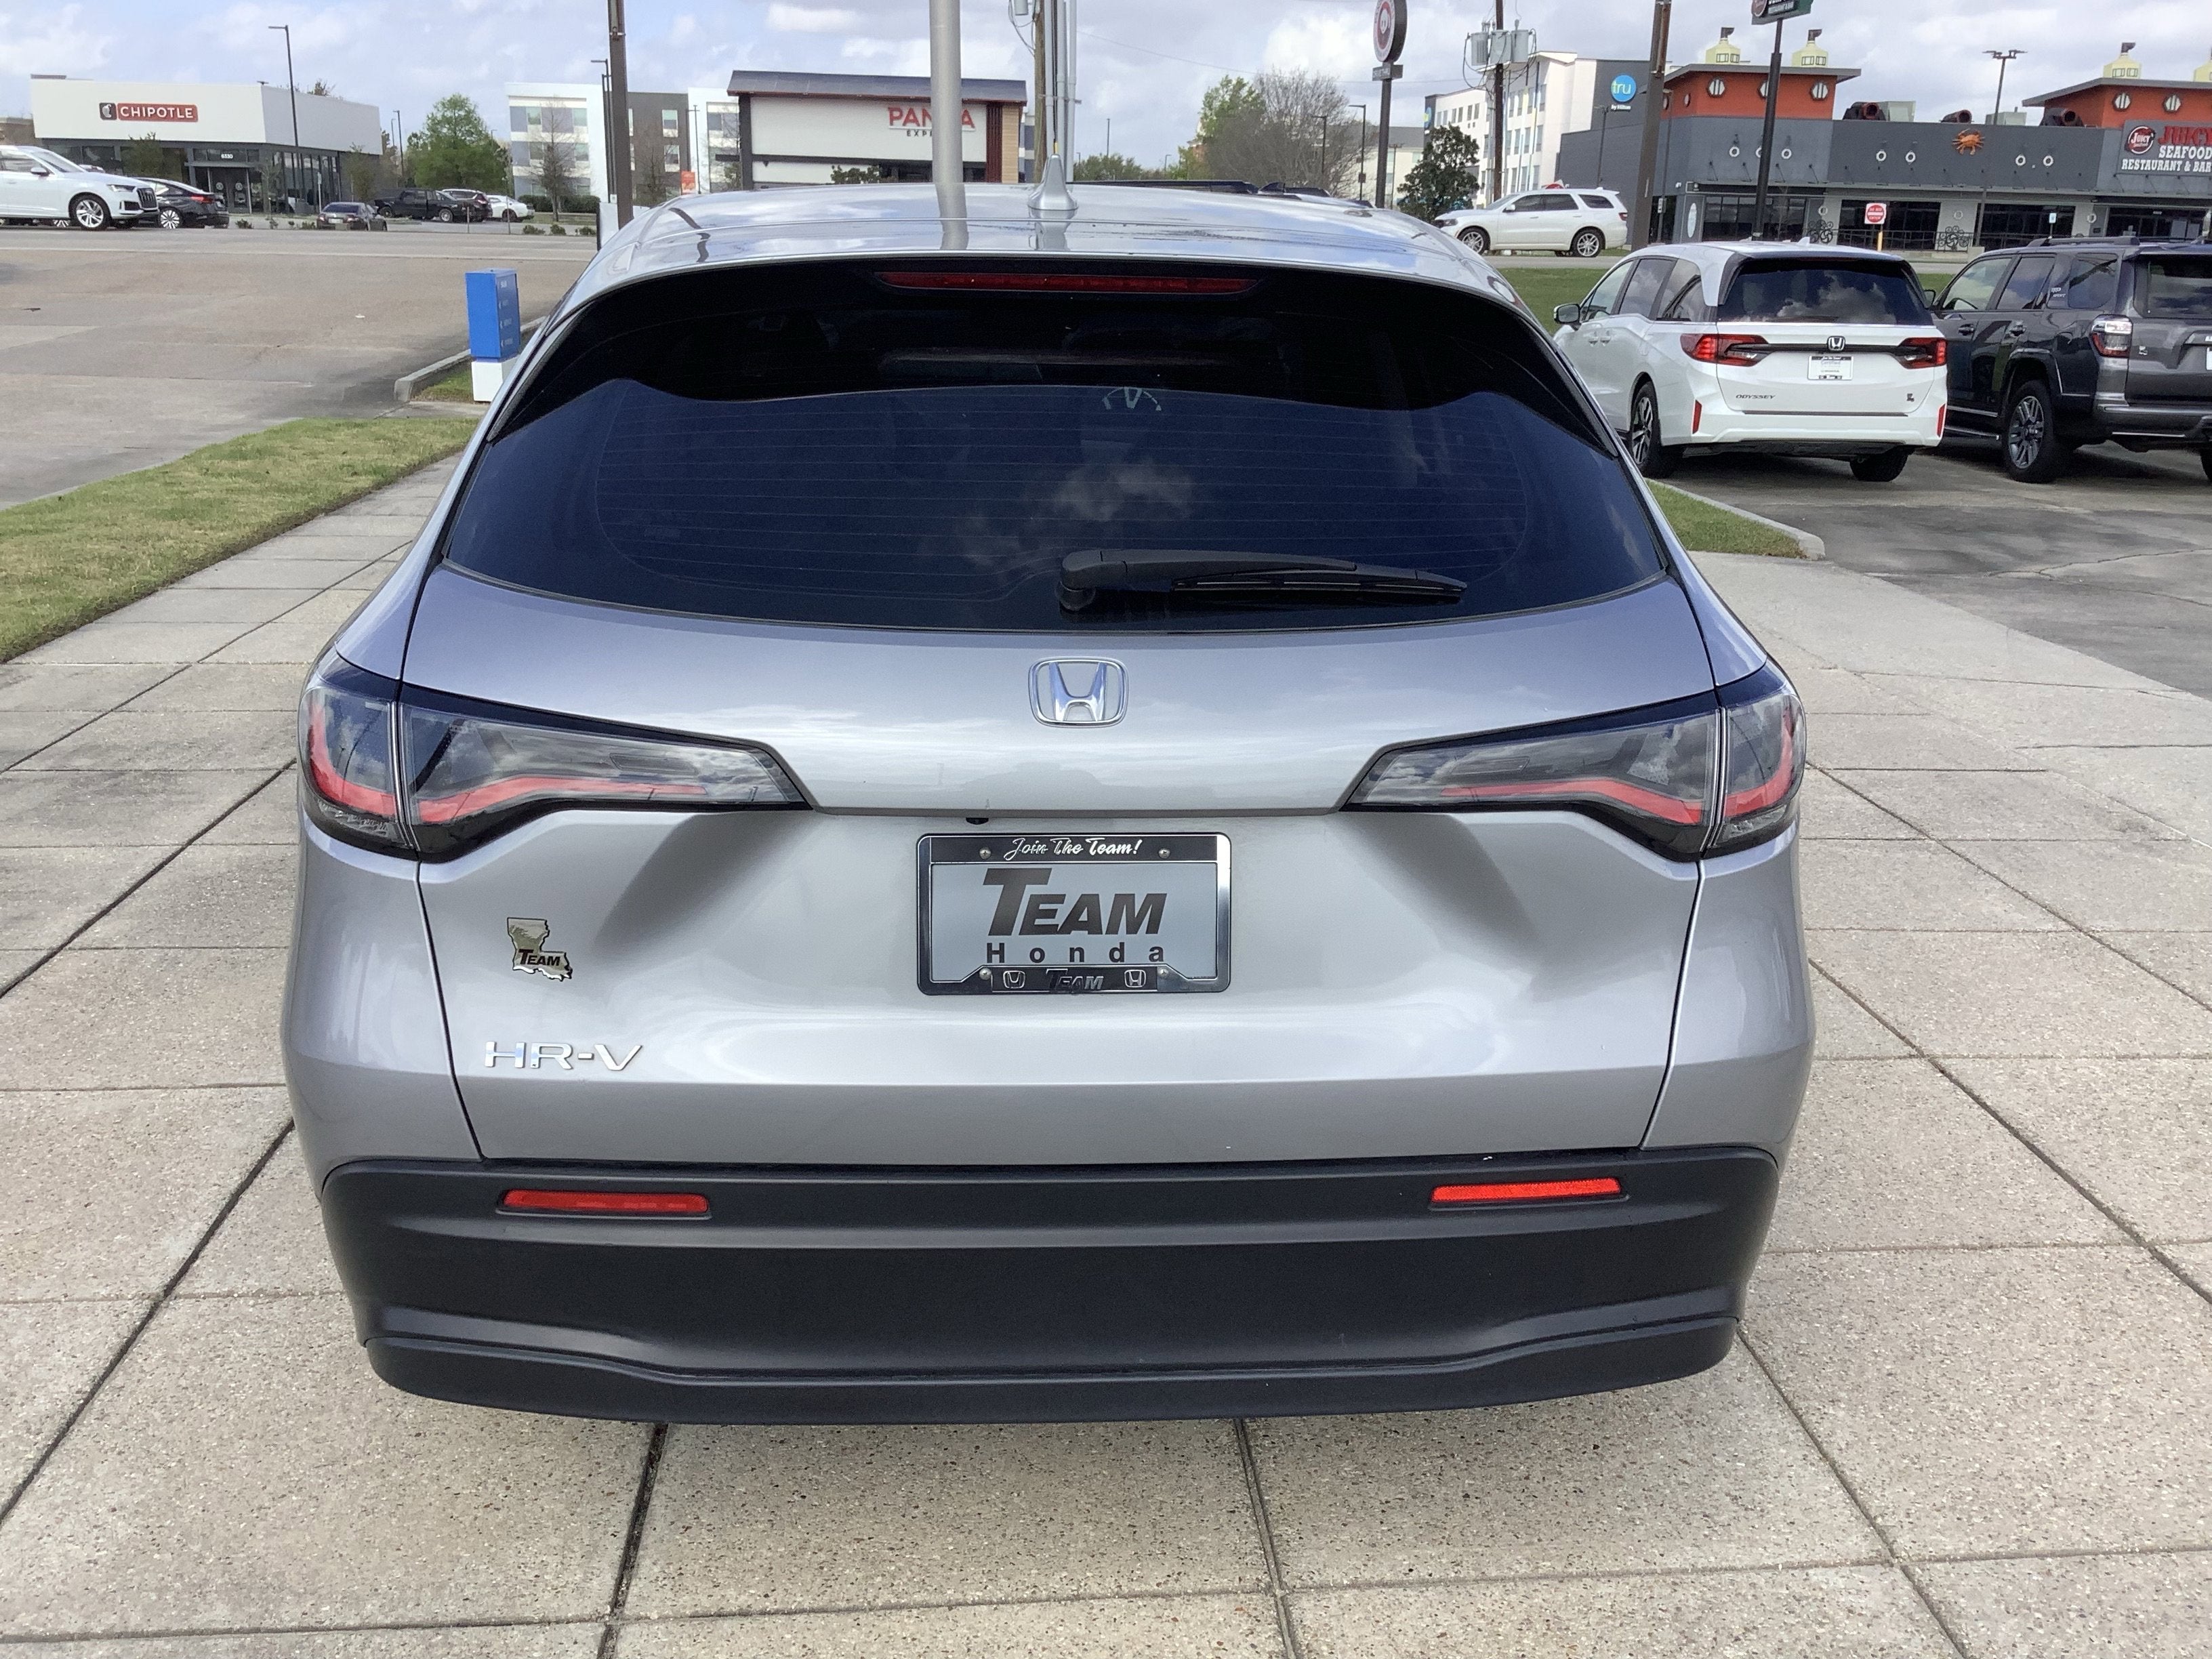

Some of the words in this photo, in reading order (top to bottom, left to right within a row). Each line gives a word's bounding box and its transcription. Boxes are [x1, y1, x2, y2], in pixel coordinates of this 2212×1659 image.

[1612, 81, 1631, 94] tru
[120, 106, 194, 119] CHIPOTLE
[888, 107, 975, 129] PANA
[2158, 145, 2212, 159] SEAFOOD
[2121, 159, 2183, 171] RESTAURANT
[2184, 161, 2191, 172] &
[2192, 161, 2212, 173] BAR
[1004, 838, 1048, 861] Join
[1050, 838, 1084, 855] The
[1085, 838, 1143, 856] Team!
[983, 867, 1168, 936] TEAM
[518, 948, 561, 966] TEAM
[987, 941, 1164, 964] Honda
[1046, 968, 1104, 992] TEAM
[485, 1041, 642, 1071] HR-V
